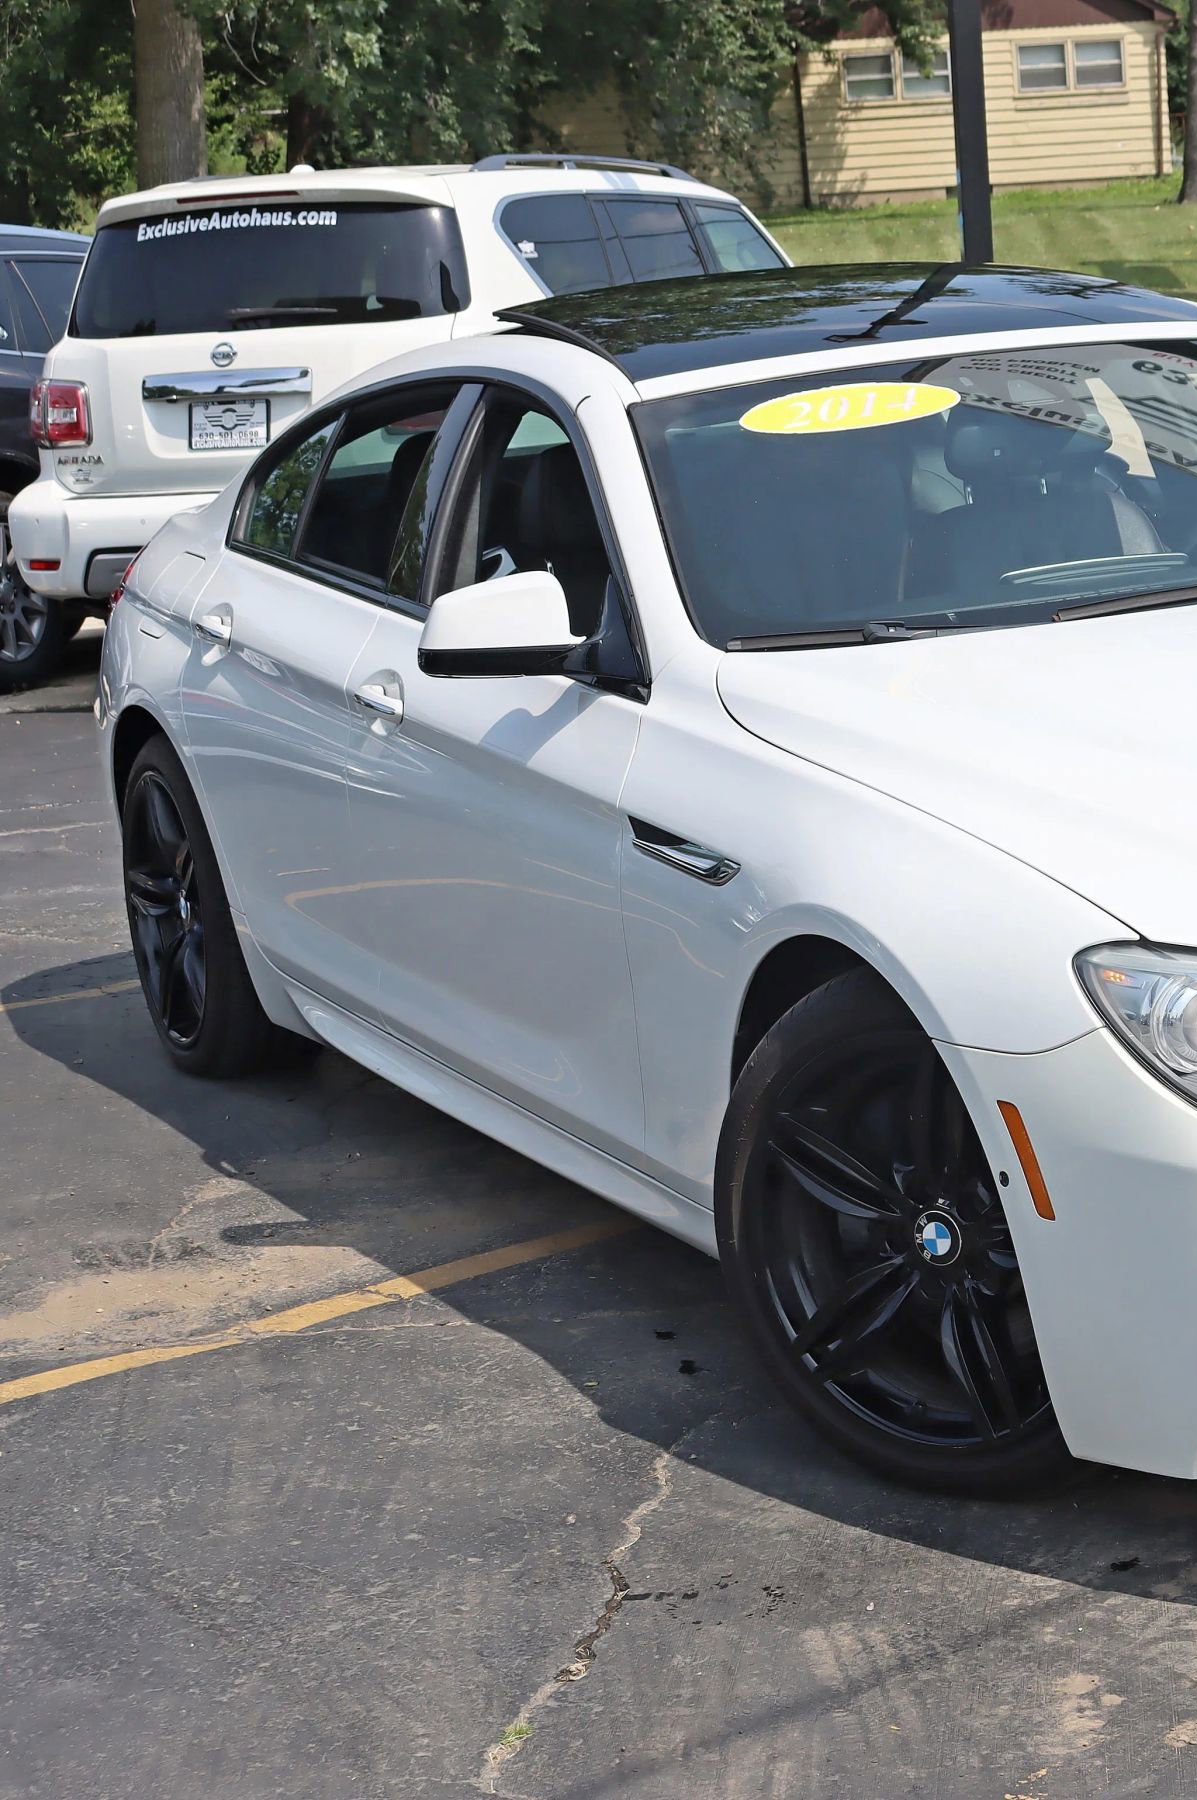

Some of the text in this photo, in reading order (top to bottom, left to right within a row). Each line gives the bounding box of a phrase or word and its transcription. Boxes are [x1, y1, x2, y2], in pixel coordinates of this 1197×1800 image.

[137, 208, 337, 242] ExclusiveAutohaus.com
[783, 386, 918, 430] 2014
[914, 1215, 932, 1260] BMW
